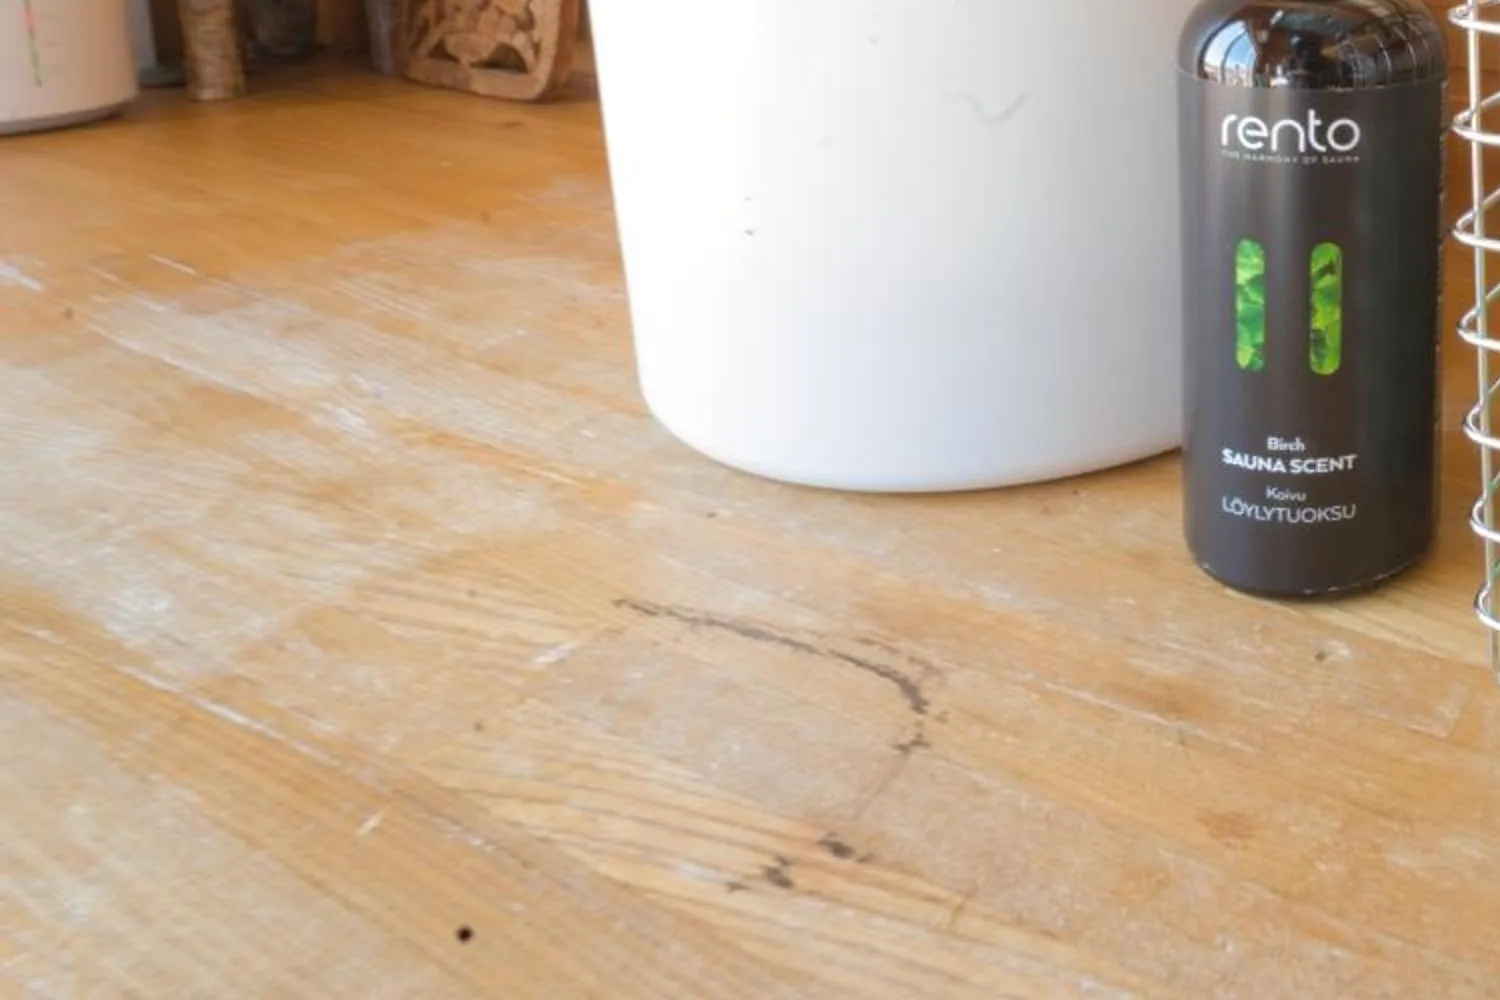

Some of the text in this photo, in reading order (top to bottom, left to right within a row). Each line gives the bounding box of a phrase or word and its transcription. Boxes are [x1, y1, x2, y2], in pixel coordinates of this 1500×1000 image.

[1220, 108, 1361, 153] rento
[1266, 436, 1306, 451] Birch
[1221, 447, 1359, 475] SAUNA SCENT
[1265, 485, 1307, 502] Koivu
[1221, 496, 1357, 524] LÖYLYTUOKSU
